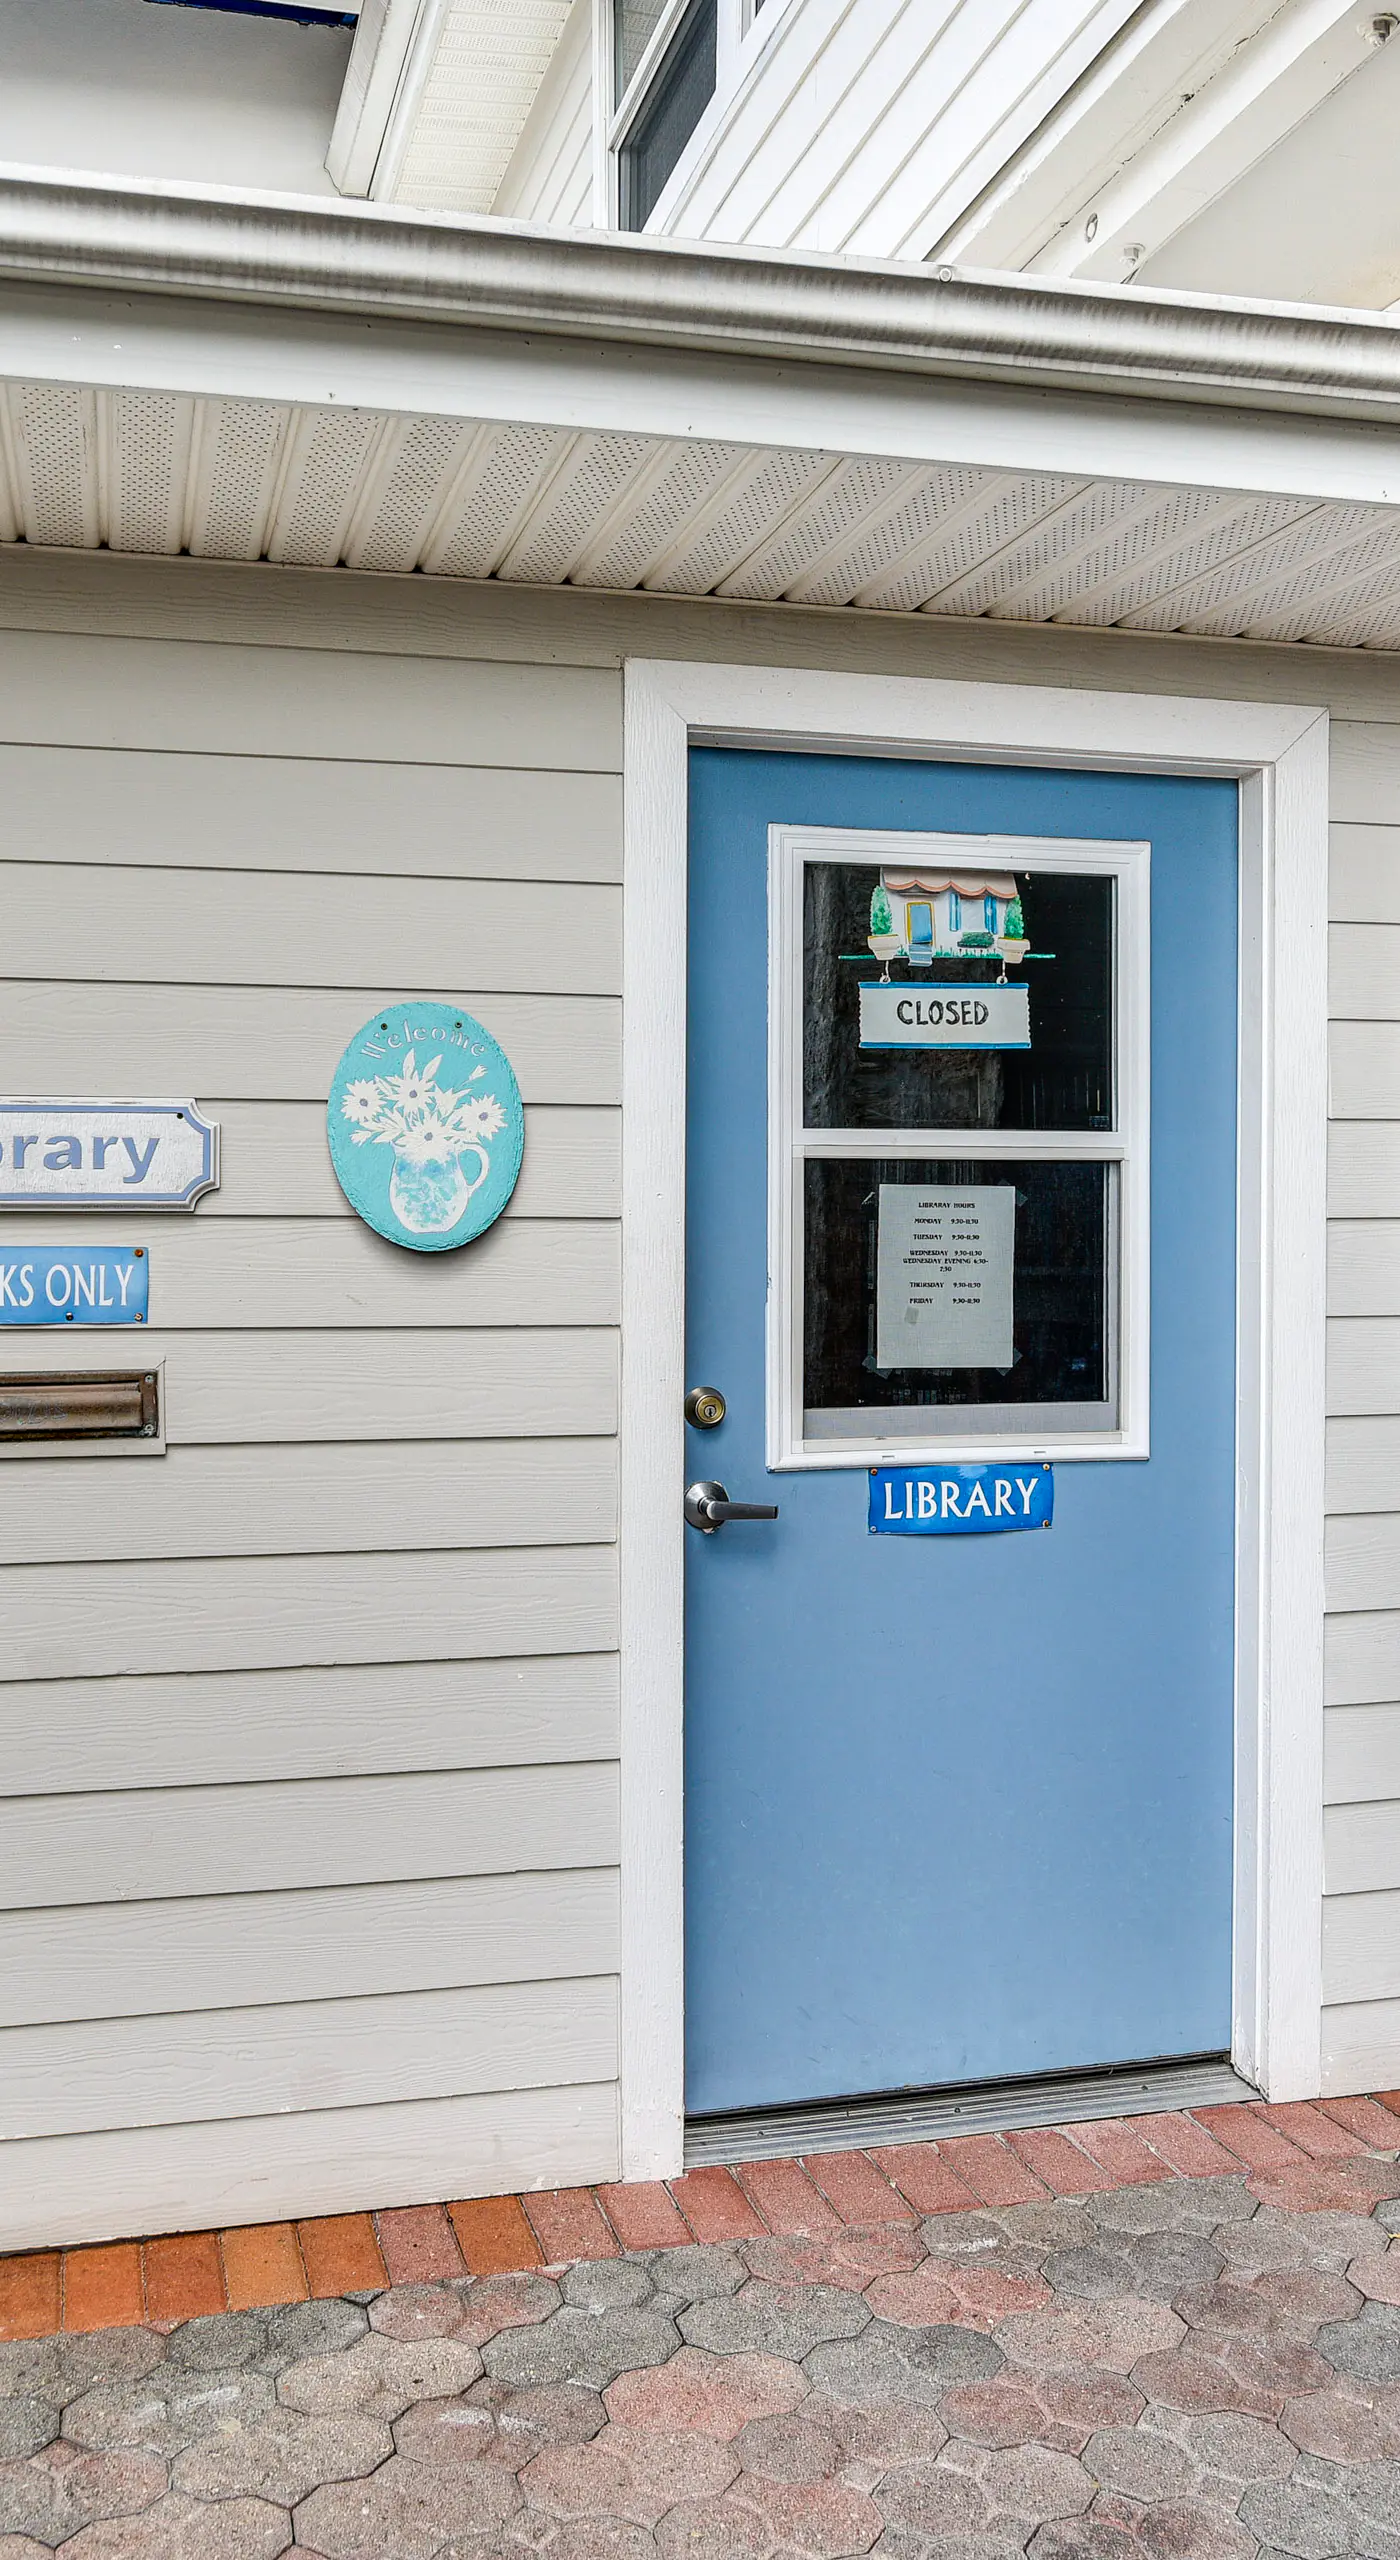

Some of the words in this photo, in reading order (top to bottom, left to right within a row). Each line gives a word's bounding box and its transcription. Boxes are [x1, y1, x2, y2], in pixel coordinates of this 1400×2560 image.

[897, 1000, 989, 1026] CLOSED
[360, 1018, 486, 1060] Welcome
[0, 1135, 161, 1184] rary
[45, 1263, 134, 1307] ONLY
[884, 1478, 1039, 1519] LIBRARY
